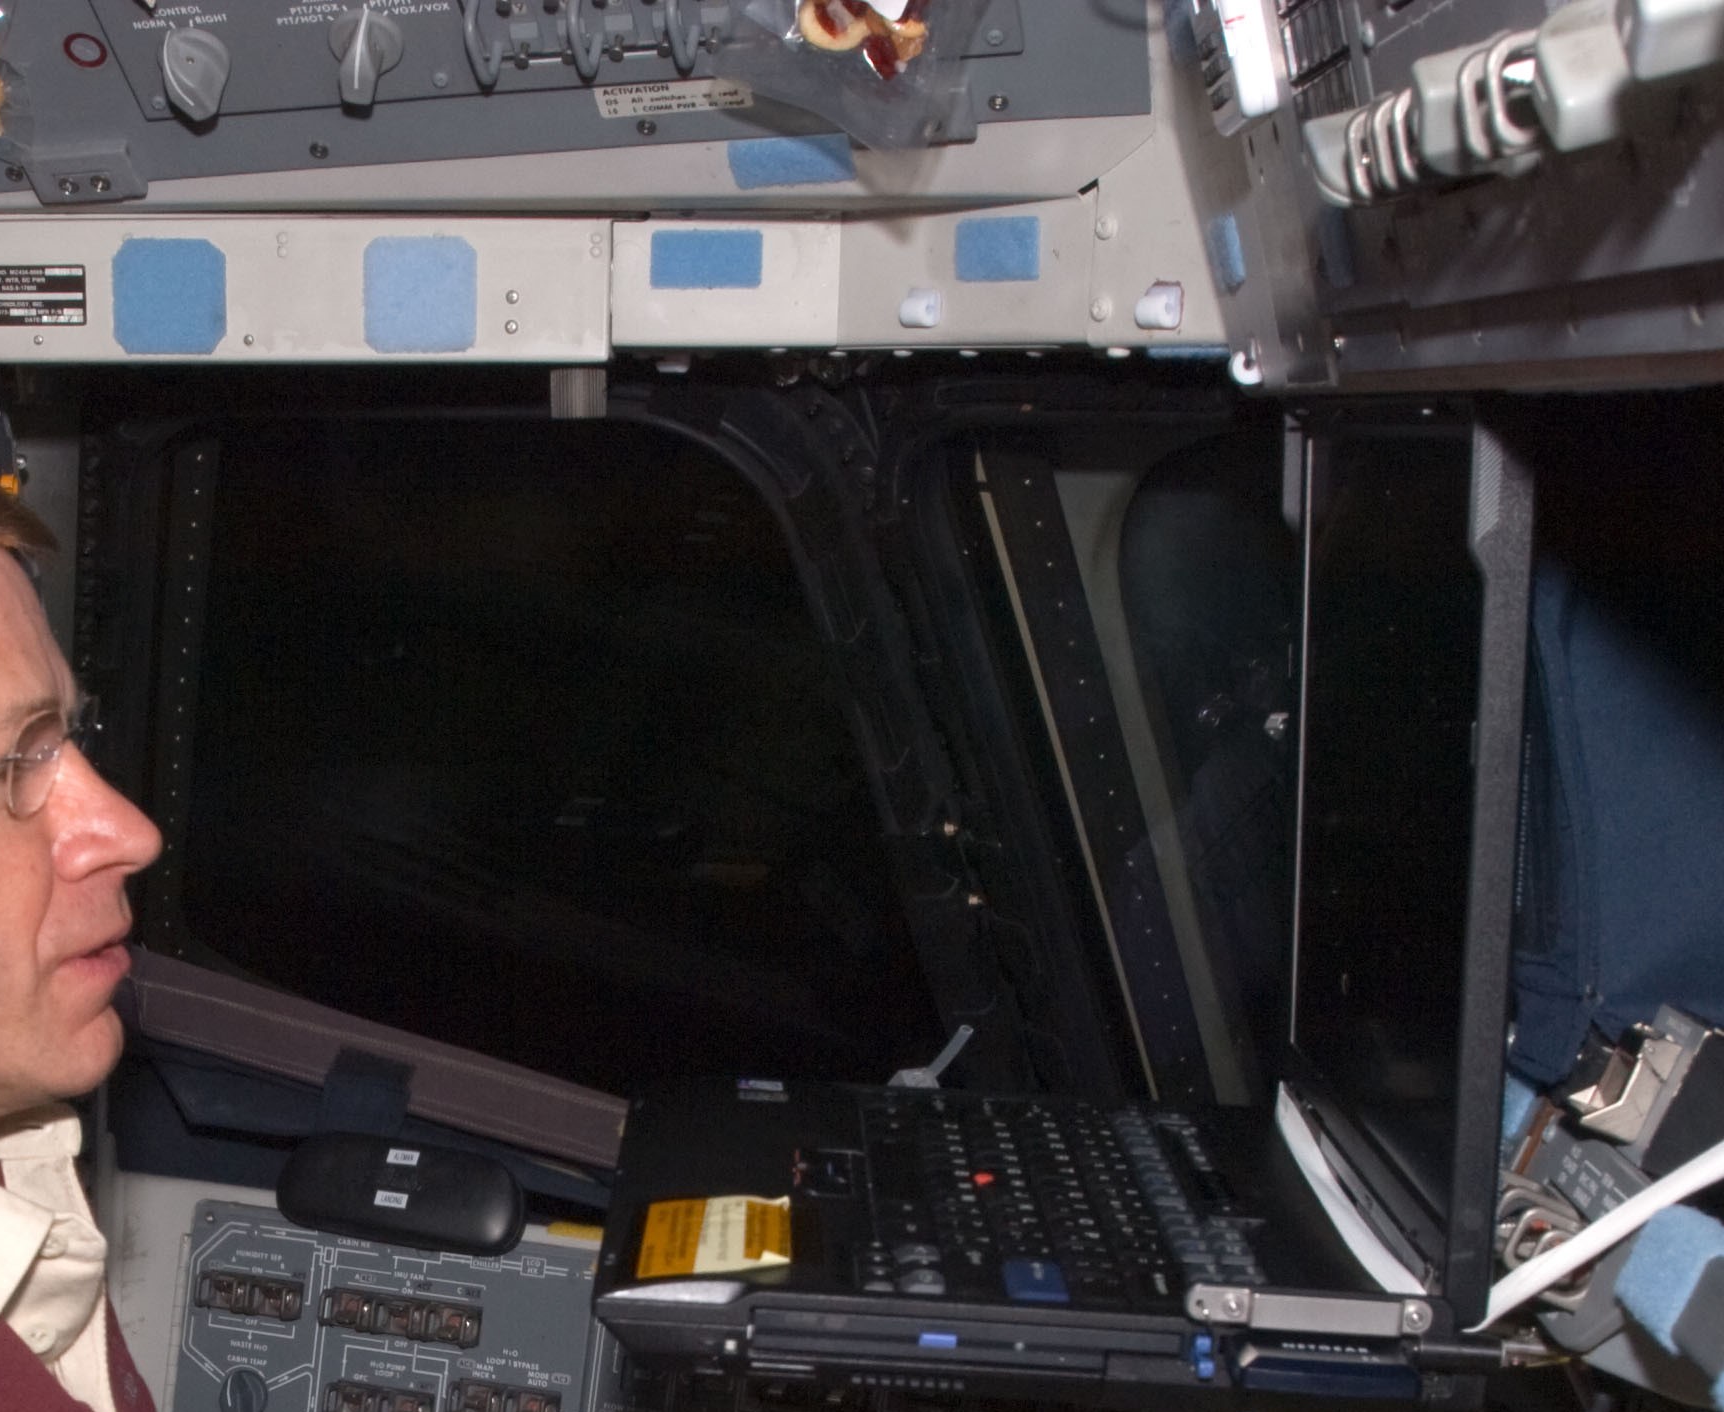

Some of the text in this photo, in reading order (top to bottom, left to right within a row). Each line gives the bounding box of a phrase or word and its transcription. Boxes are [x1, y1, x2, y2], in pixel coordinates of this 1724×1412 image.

[392, 2, 450, 15] VOX/VOX
[133, 14, 228, 30] NORM RIGHT
[276, 14, 324, 26] PTT/HOT
[602, 83, 670, 97] ACTIVATION
[380, 1194, 404, 1206] LANDING
[338, 1238, 359, 1248] CABIN
[235, 1249, 283, 1263] HUMIDITY SEP
[471, 1259, 501, 1269] CHILLER
[251, 1266, 264, 1275] ON
[393, 1271, 425, 1282] IMU FAN
[401, 1287, 414, 1296] ON
[244, 1318, 259, 1327] OFF
[230, 1339, 253, 1350] WASTE
[394, 1340, 408, 1350] OFF
[227, 1354, 268, 1367] CABIN TEMP
[486, 1357, 540, 1371] LOOP BYPASS
[476, 1363, 494, 1373] MAN
[374, 1370, 395, 1379] LOOP
[527, 1371, 550, 1381] MODE
[527, 1379, 549, 1388] AUTO
